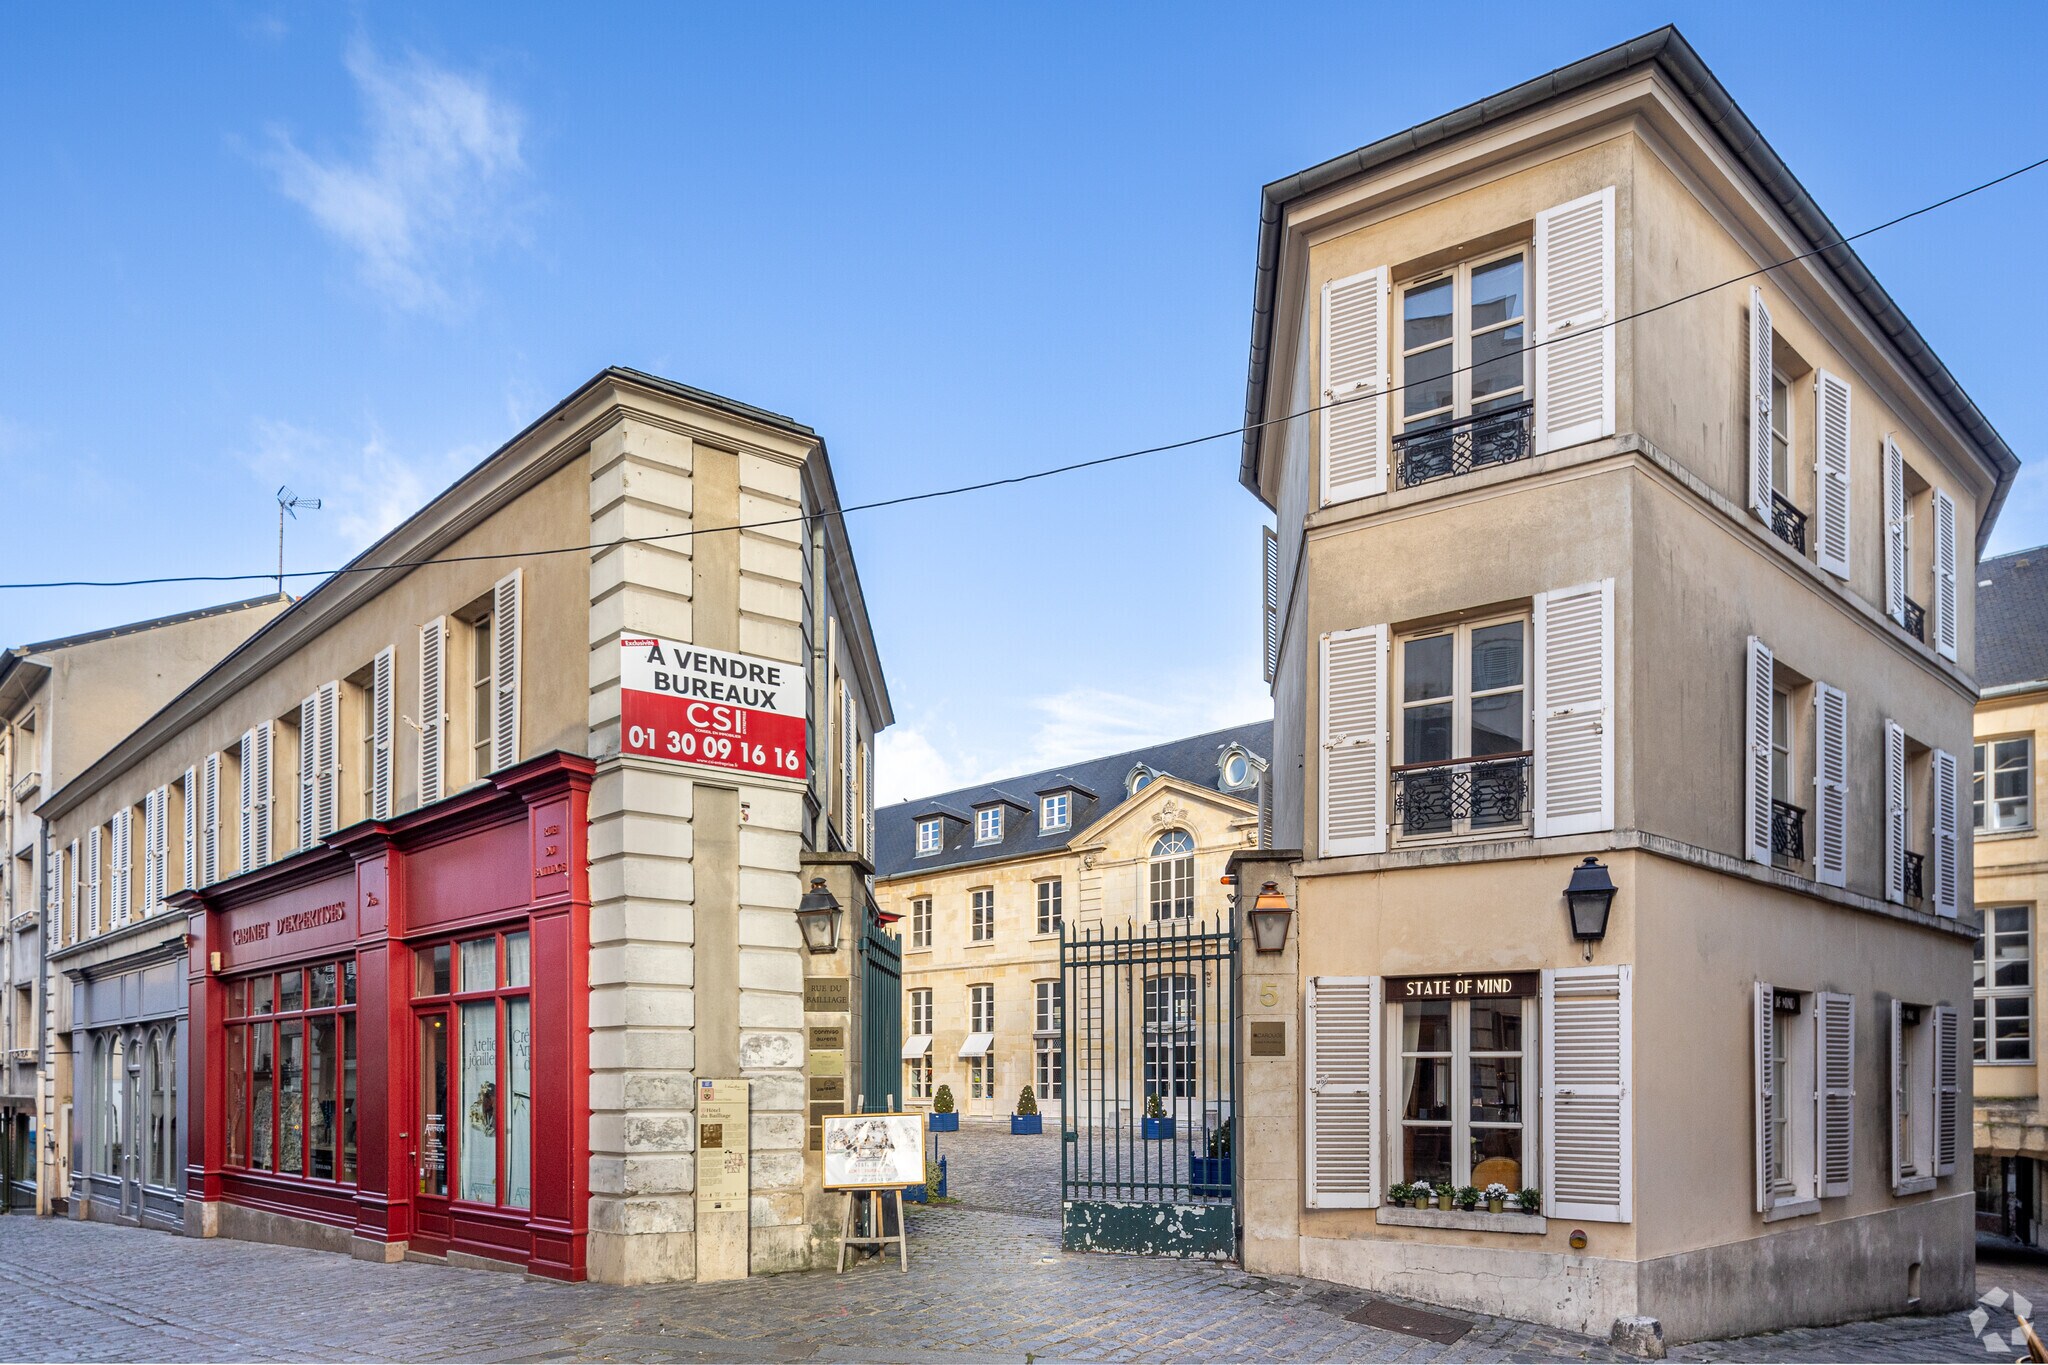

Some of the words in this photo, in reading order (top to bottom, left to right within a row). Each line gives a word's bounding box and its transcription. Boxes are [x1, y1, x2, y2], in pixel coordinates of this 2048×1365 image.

[674, 649, 781, 687] VENDRE
[654, 671, 777, 710] BUREAUX
[686, 702, 742, 734] CSI
[629, 725, 656, 750] 01
[667, 731, 696, 756] 30
[703, 736, 732, 760] 09
[741, 742, 766, 766] 16
[774, 747, 799, 771] 16
[544, 825, 560, 837] RUE
[232, 922, 270, 946] CABINET
[276, 901, 346, 935] D'EXPERTISES
[806, 996, 847, 1004] BAILLIAGE
[1260, 982, 1279, 1007] 5
[1406, 981, 1451, 996] STATE
[1455, 980, 1472, 994] OF
[1477, 978, 1512, 994] MIND
